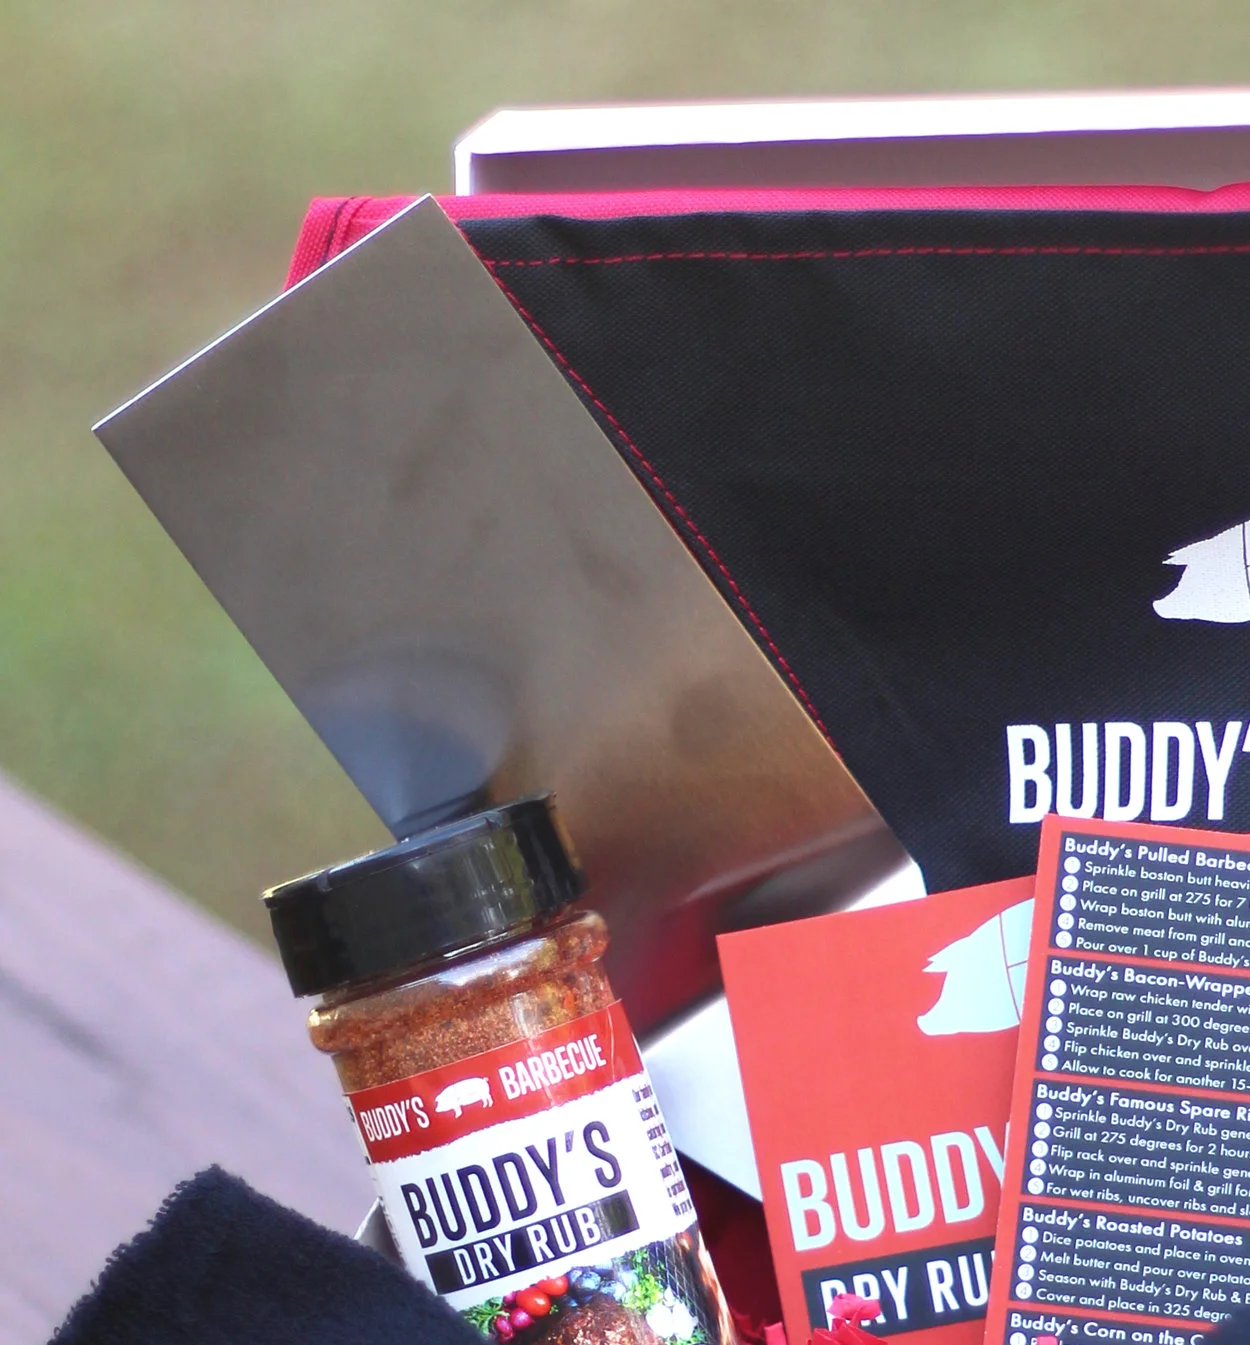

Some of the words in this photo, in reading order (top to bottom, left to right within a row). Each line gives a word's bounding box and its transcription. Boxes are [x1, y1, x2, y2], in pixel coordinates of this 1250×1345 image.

[1064, 837, 1132, 861] Buddy's
[1137, 844, 1190, 865] Pulled
[1084, 860, 1136, 878] Sprinkle
[1139, 865, 1183, 883] boston
[1186, 871, 1212, 886] butt
[1082, 879, 1118, 895] Place
[1140, 887, 1166, 902] grill
[1185, 891, 1211, 905] 275
[1079, 898, 1118, 917] Wrap
[1120, 902, 1164, 919] boston
[1167, 907, 1192, 922] butt
[1195, 912, 1222, 925] with
[1077, 917, 1129, 934] Remove
[1132, 927, 1165, 938] meat
[1167, 926, 1197, 942] from
[1200, 932, 1226, 946] grill
[1075, 936, 1105, 951] Pour
[1107, 943, 1138, 954] over
[1153, 948, 1178, 962] cup
[1198, 950, 1250, 969] Buddy's
[1050, 959, 1118, 983] Buddy's
[1070, 983, 1108, 1001] Wrap
[1110, 991, 1136, 1001] raw
[1139, 991, 1188, 1008] chicken
[1191, 998, 1234, 1012] tender
[1068, 1001, 1104, 1017] Place
[1126, 1009, 1152, 1024] grill
[1171, 1013, 1200, 1028] 300
[1065, 1021, 1118, 1038] Sprinkle
[1122, 1027, 1174, 1046] Buddy's
[1176, 1033, 1201, 1050] Dry
[1204, 1036, 1229, 1051] Rub
[1063, 1039, 1087, 1056] Flip
[1090, 1042, 1139, 1060] chicken
[1142, 1052, 1172, 1063] over
[1174, 1054, 1202, 1067] and
[360, 1096, 430, 1142] BUDDY'S
[499, 1034, 607, 1100] BARBECUE
[1060, 1059, 1100, 1074] Allow
[1118, 1066, 1151, 1080] cook
[1175, 1073, 1226, 1088] another
[1036, 1083, 1104, 1107] Buddy's
[1109, 1091, 1174, 1113] Famous
[1179, 1099, 1231, 1119] Spare
[1054, 1106, 1106, 1124] Sprinkle
[1110, 1112, 1162, 1131] Buddy's
[1165, 1118, 1190, 1136] Dry
[1192, 1121, 1218, 1136] Rub
[1052, 1125, 1081, 1139] Grill
[1100, 1130, 1126, 1144] 275
[1129, 1133, 1182, 1151] degrees
[1050, 1144, 1073, 1161] Flip
[1076, 1148, 1104, 1162] rack
[1108, 1154, 1138, 1165] over
[1140, 1156, 1167, 1169] and
[1169, 1160, 1219, 1175] sprinkle
[400, 1120, 622, 1250] BUDDY'S
[1048, 1163, 1085, 1181] Wrap
[1103, 1169, 1166, 1188] aluminum
[1168, 1175, 1190, 1190] foil
[1206, 1182, 1232, 1197] grill
[1046, 1181, 1067, 1195] For
[1069, 1188, 1094, 1198] wet
[1127, 1194, 1180, 1208] uncover
[1183, 1197, 1207, 1211] ribs
[1209, 1202, 1237, 1215] and
[1022, 1206, 1090, 1231] Buddy's
[1095, 1214, 1165, 1237] Roasted
[1169, 1223, 1243, 1246] Potatoes
[453, 1231, 516, 1287] DRY
[529, 1206, 601, 1263] RUB
[926, 1251, 996, 1315] RU
[1010, 1312, 1078, 1337] Buddy's
[1083, 1321, 1126, 1340] Corn
[1130, 1331, 1153, 1343] on
